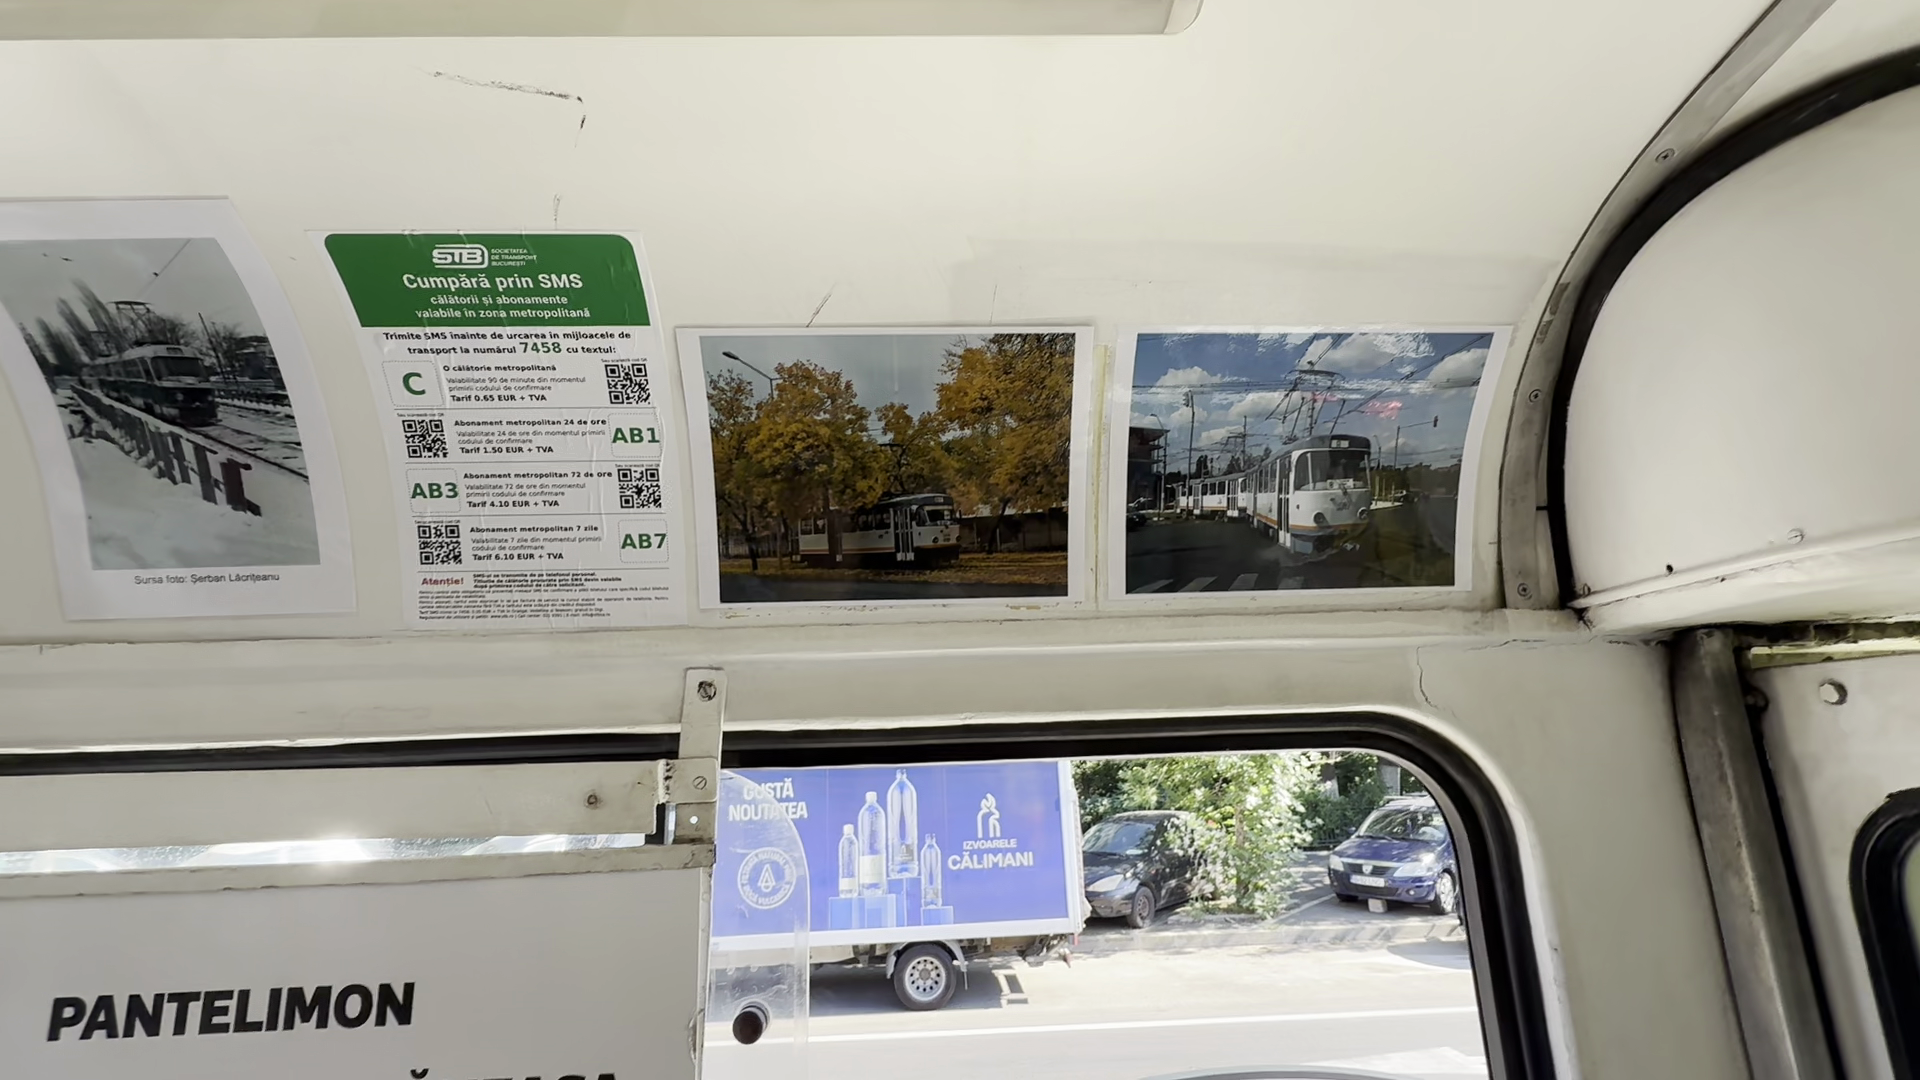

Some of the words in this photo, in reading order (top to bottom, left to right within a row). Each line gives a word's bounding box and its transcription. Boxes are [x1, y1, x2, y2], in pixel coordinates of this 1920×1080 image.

[432, 248, 483, 264] STB
[402, 273, 491, 292] Cumpără
[495, 274, 534, 292] prin
[538, 273, 583, 289] SMS
[430, 295, 479, 305] călătorii
[482, 295, 493, 306] și
[496, 294, 568, 305] abonamente
[415, 308, 461, 319] valabile
[464, 308, 477, 318] în
[479, 310, 507, 318] zona
[509, 307, 591, 319] metropolitană
[382, 332, 422, 340] Trimite
[424, 332, 448, 340] SMS
[450, 331, 488, 340] înainte
[490, 331, 504, 339] de
[549, 331, 560, 339] în
[562, 331, 615, 341] mijloacele
[618, 331, 631, 339] de
[407, 347, 458, 356] transport
[459, 346, 470, 354] la
[473, 346, 516, 354] numărul
[519, 341, 562, 354] 7458
[581, 345, 616, 354] textul:
[452, 364, 492, 372] călătorie
[494, 364, 557, 372] metropolitană
[402, 371, 426, 396] C
[450, 394, 472, 402] Tarif
[474, 394, 495, 402] 0.65
[505, 419, 561, 427] metropolitan
[611, 427, 660, 444] AB1
[514, 472, 569, 480] metropolitan
[411, 482, 459, 499] AB3
[520, 525, 574, 533] metropolitan
[621, 533, 667, 550] AB7
[494, 553, 515, 561] 6.10
[134, 575, 163, 584] Sursa
[166, 574, 188, 584] foto:
[190, 573, 226, 585] Șerban
[421, 577, 464, 587] Atenție!
[743, 777, 794, 801] GUSTĂ
[728, 801, 808, 821] NOUTATEA
[963, 838, 1018, 850] IZVOARELE
[947, 851, 1034, 871] CĂLIMANI
[47, 982, 416, 1042] PANTELIMON
